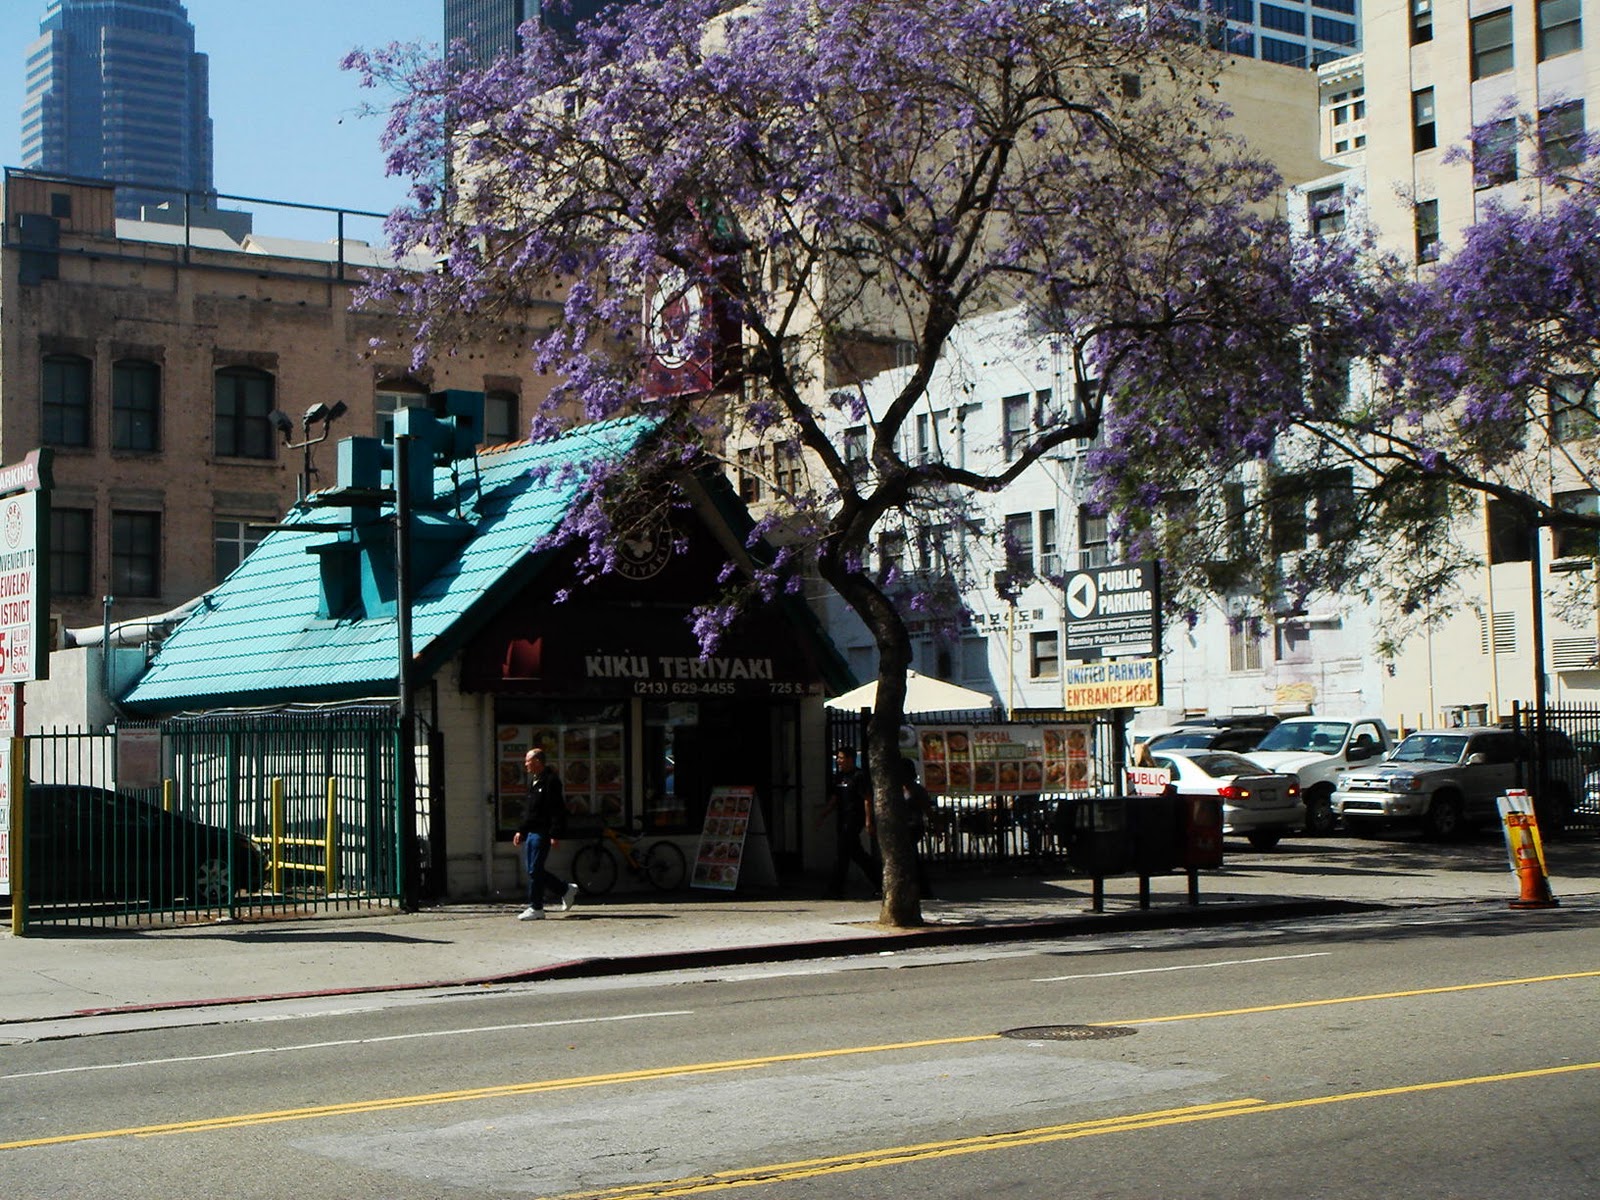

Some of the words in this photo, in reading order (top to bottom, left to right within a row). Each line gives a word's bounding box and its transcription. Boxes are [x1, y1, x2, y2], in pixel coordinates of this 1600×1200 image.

[1098, 568, 1143, 592] PUBLIC
[1098, 590, 1153, 616] PARKING
[584, 649, 650, 679] KIKU
[658, 656, 774, 680] TERIYAKI
[1067, 666, 1105, 684] UNIFIED
[1108, 661, 1153, 683] PARKING
[633, 681, 668, 695] (213)
[671, 681, 737, 695] 629-4455
[769, 682, 793, 694] 725
[1067, 686, 1123, 706] ENTRANCE
[1126, 683, 1153, 703] HERE
[1127, 772, 1167, 786] PUBLIC
